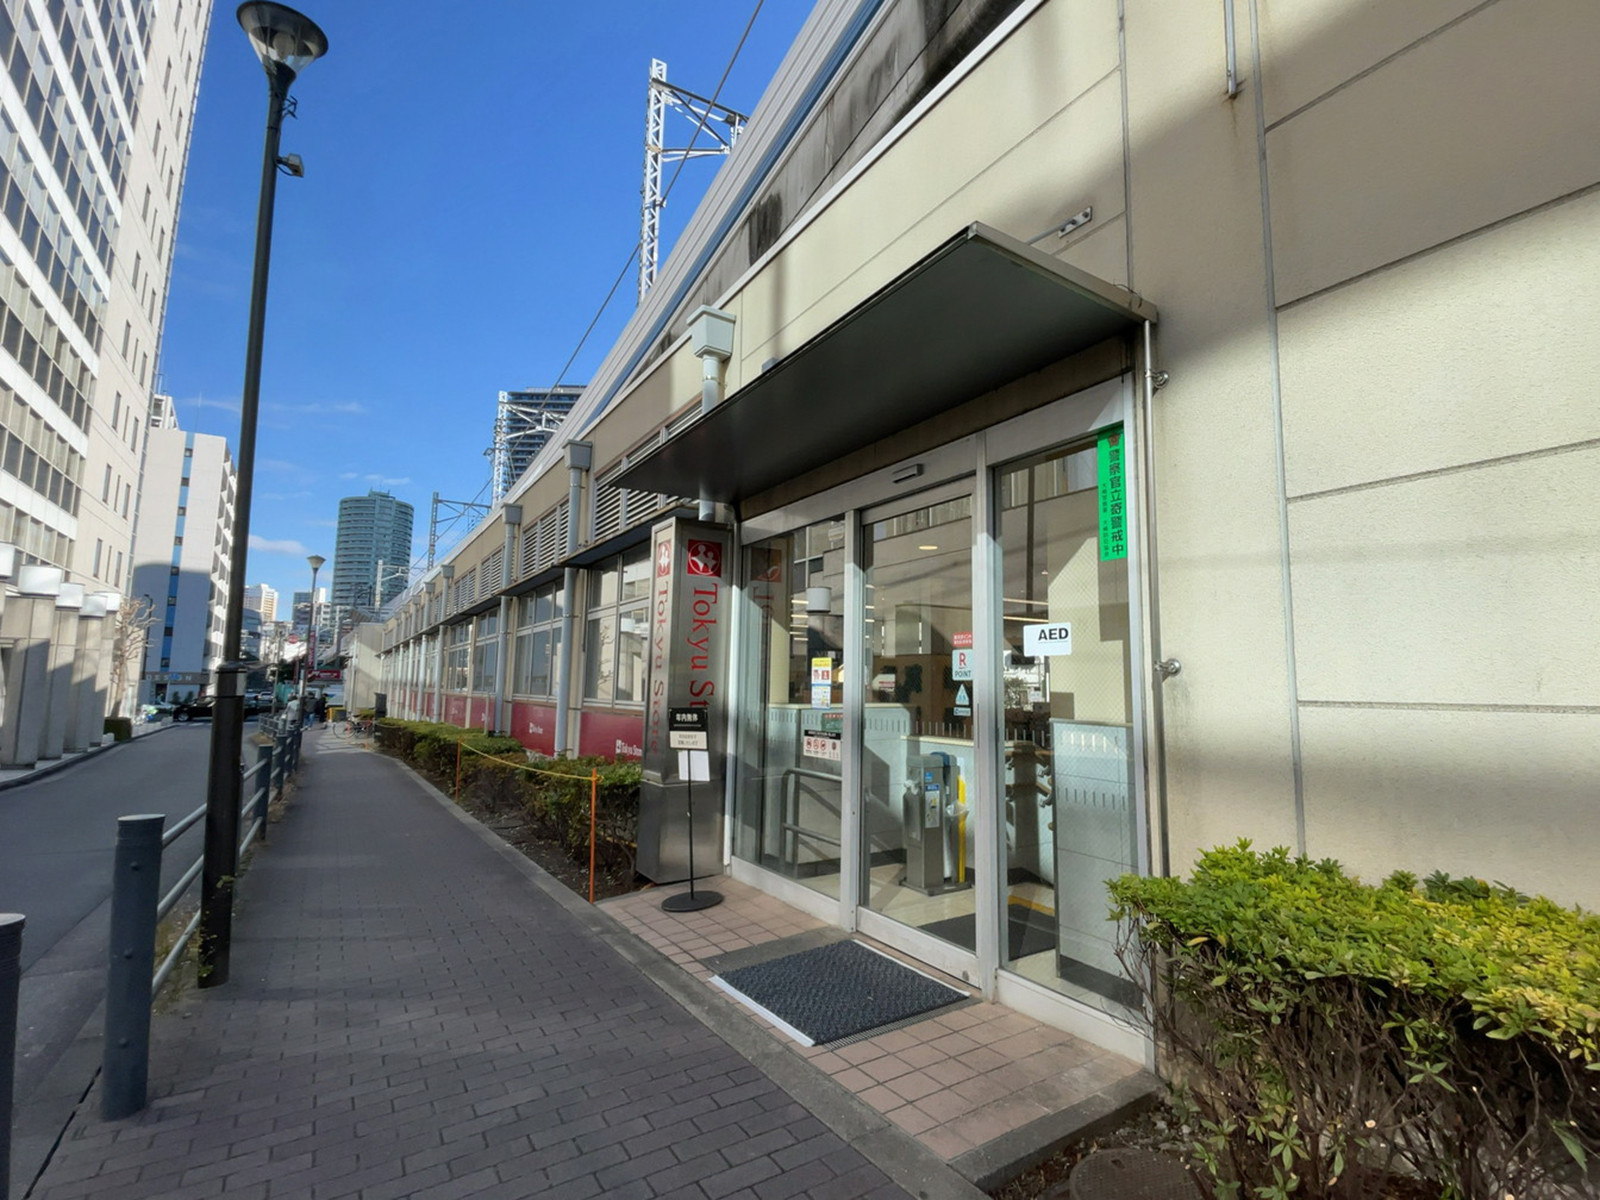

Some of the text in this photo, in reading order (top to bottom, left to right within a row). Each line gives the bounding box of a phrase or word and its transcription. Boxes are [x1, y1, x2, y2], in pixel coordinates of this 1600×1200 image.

[1109, 448, 1125, 556] 警察官立寄警戒中
[687, 582, 718, 707] Tokyu St
[959, 652, 967, 666] R
[1038, 627, 1069, 641] AED
[651, 581, 669, 755] Tokyu Store
[954, 670, 972, 678] POINT
